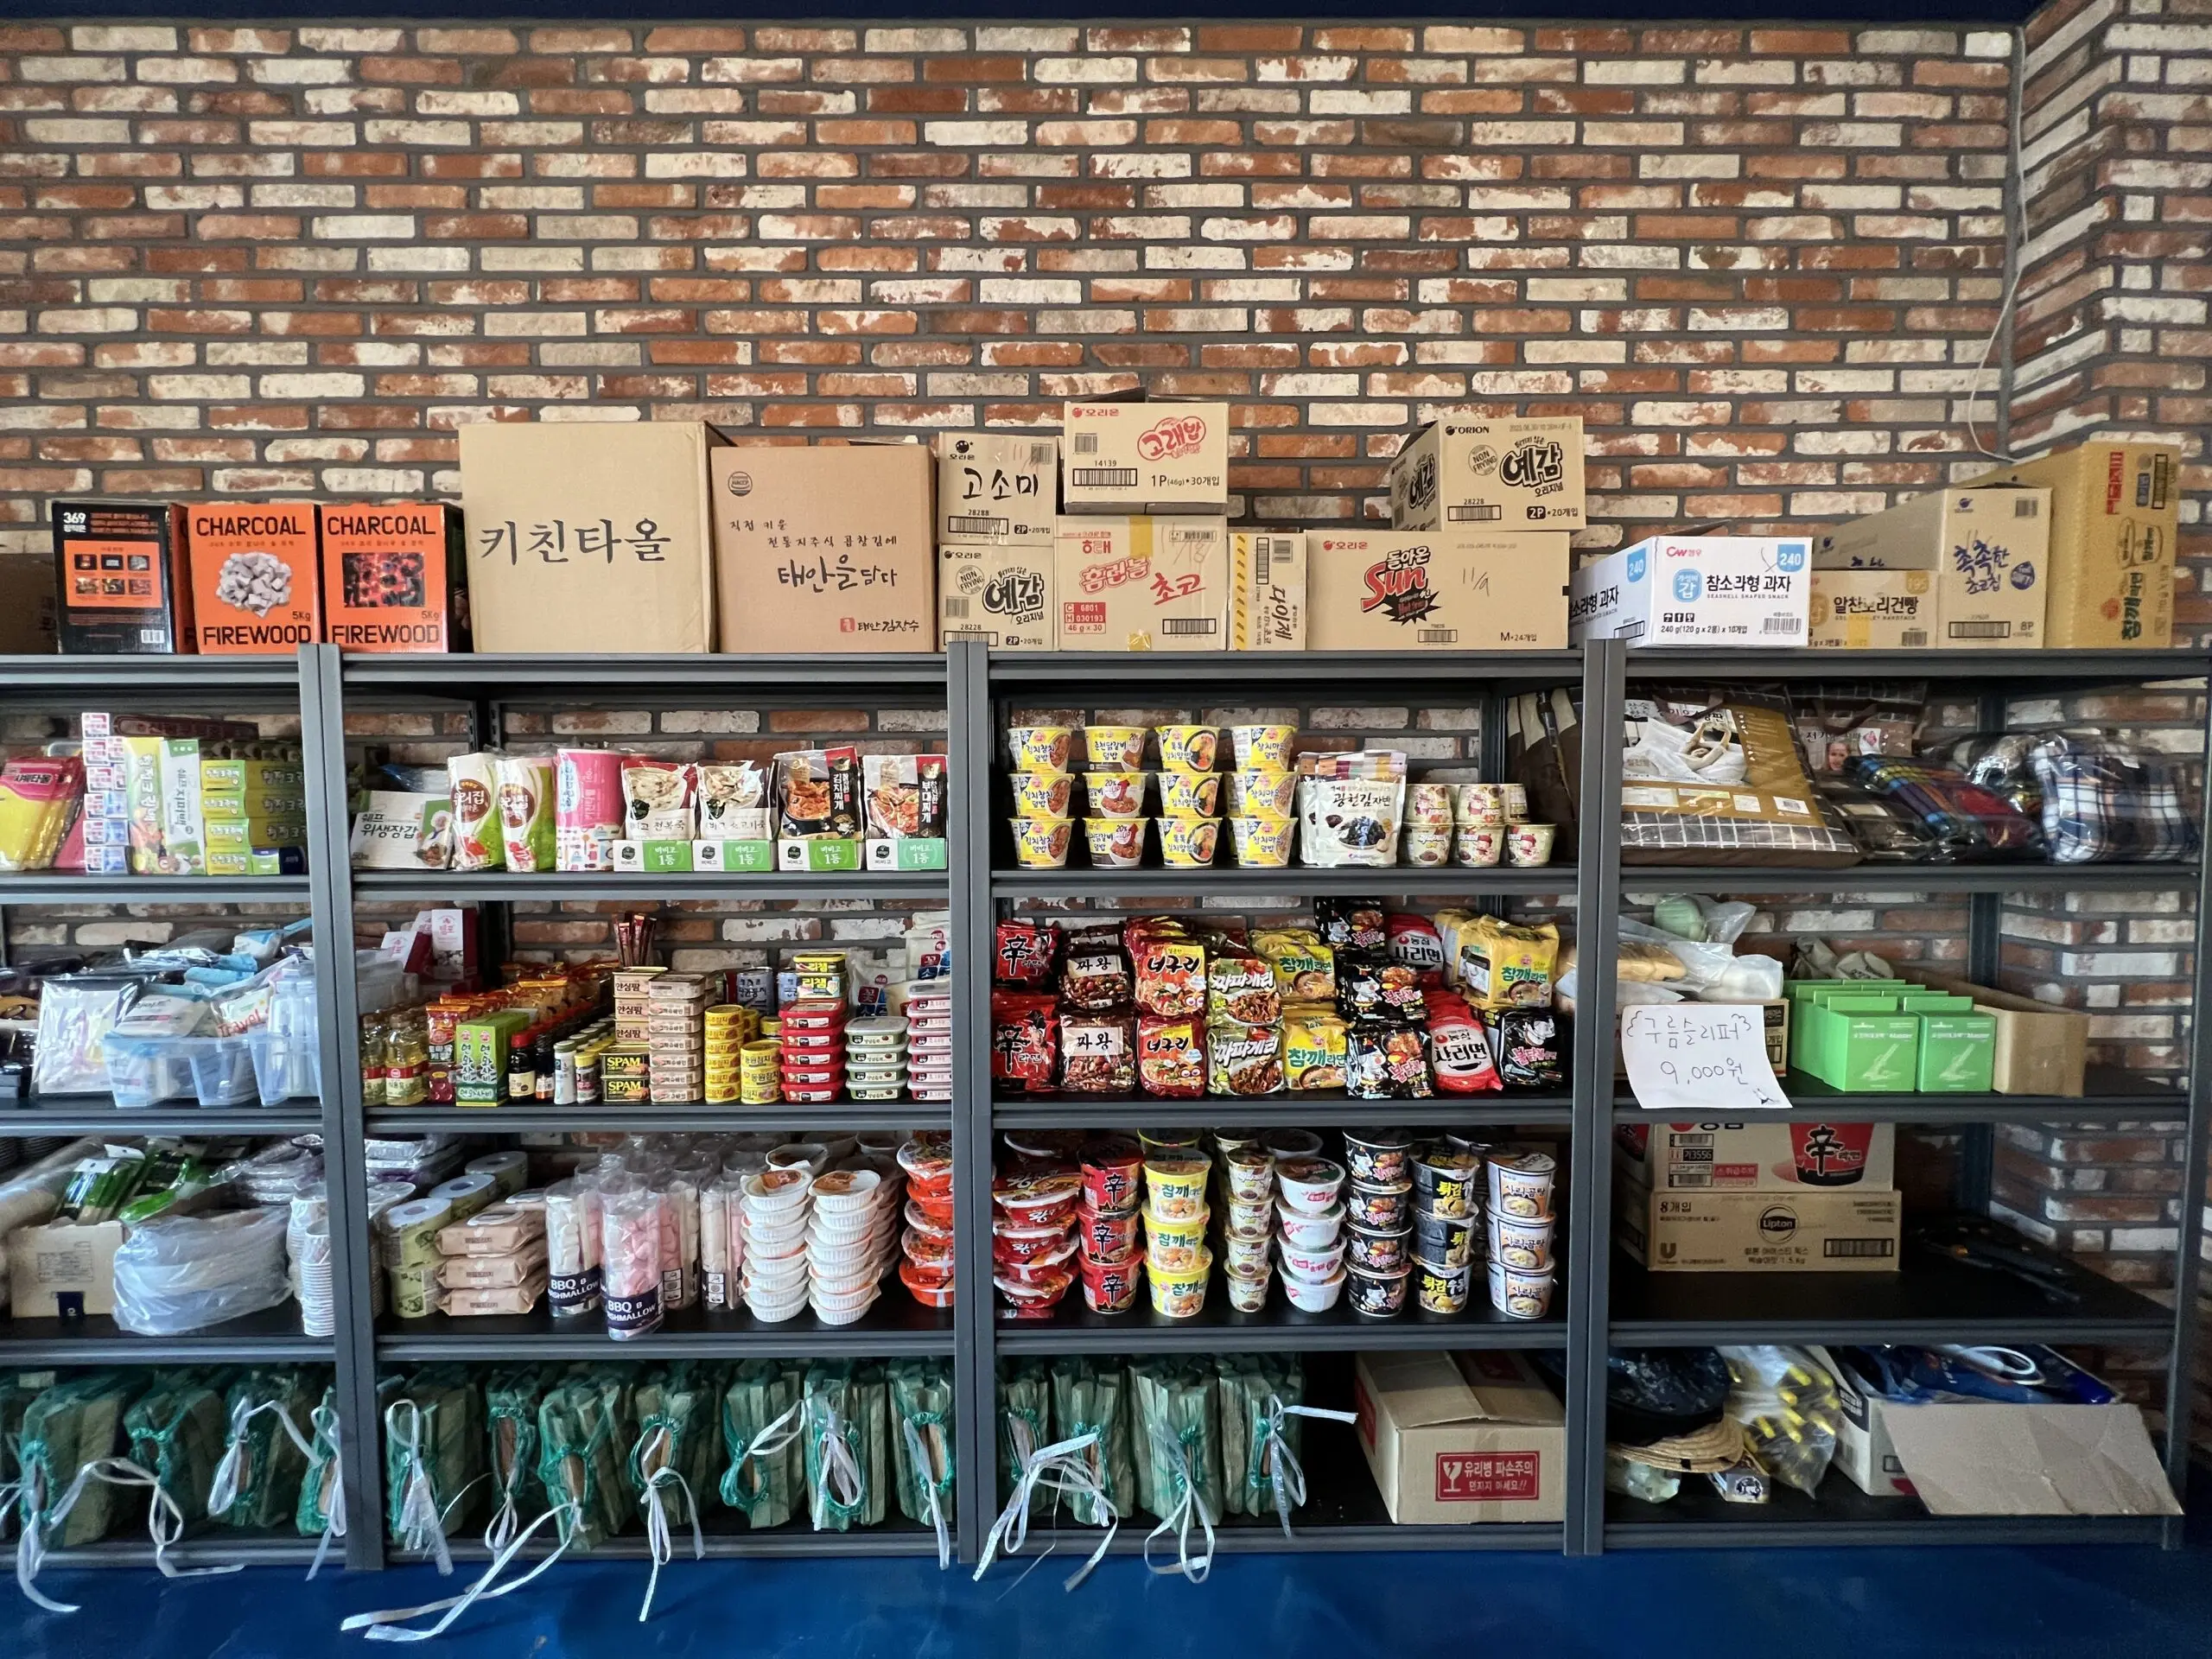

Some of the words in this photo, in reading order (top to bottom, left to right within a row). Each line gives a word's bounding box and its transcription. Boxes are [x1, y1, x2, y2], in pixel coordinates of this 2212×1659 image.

[1141, 421, 1201, 457] 고래밥
[1472, 450, 1490, 462] NON
[1472, 456, 1497, 472] FRYING
[1502, 442, 1562, 486] 예감
[963, 467, 1039, 500] 고소미
[1535, 483, 1564, 497] 오리지널
[63, 512, 86, 524] 369
[1529, 507, 1544, 518] 2P
[196, 516, 306, 536] CHARCOAL
[327, 516, 435, 536] CHARCOAL
[730, 520, 754, 531] 직접
[764, 519, 787, 531] 키운
[1016, 525, 1027, 534] 2P
[480, 518, 671, 565] 키친타올
[768, 536, 834, 548] 전통지주식
[844, 535, 897, 546] 곱창김에
[1336, 541, 1368, 550] 오리온
[1387, 546, 1431, 570] 돌아온
[1780, 552, 1801, 565] 240
[1954, 540, 2010, 577] 촉촉한
[1628, 559, 1643, 575] 240
[960, 570, 977, 582] NON
[1707, 575, 1759, 592] 참소라형
[1764, 575, 1790, 592] 과자
[960, 577, 984, 591] FRYING
[1150, 572, 1206, 605] 초코
[1361, 561, 1427, 613] Sun
[1679, 582, 1696, 598] 갑
[1966, 574, 2001, 594] 초코칩
[985, 574, 1044, 613] 예감
[1599, 586, 1619, 607] 과자
[292, 611, 311, 621] 5Kg
[422, 611, 440, 621] 5Kg
[1016, 612, 1045, 625] 오리지널
[1269, 585, 1293, 640] 다이제
[2020, 621, 2033, 631] 8P
[203, 625, 311, 645] FIREWOOD
[332, 624, 440, 644] FIREWOOD
[1007, 637, 1020, 645] 2P
[833, 773, 844, 810] 김치찌개
[921, 781, 931, 823] 부대찌개
[361, 814, 385, 823] 쉐프
[653, 820, 685, 831] 전복죽
[361, 823, 418, 838] 위생장갑
[658, 855, 676, 866] 1등
[739, 854, 755, 865] 1등
[824, 854, 842, 865] 1등
[913, 854, 930, 864] 1등
[1409, 937, 1430, 945] 농심
[1001, 934, 1034, 975] 辛
[1394, 945, 1441, 963] 사리면
[809, 963, 828, 972] 리챔
[1077, 956, 1112, 972] 짜왕
[1147, 956, 1199, 975] 너구리
[1502, 965, 1548, 982] 참깨라면
[616, 982, 640, 991] 안심팜
[802, 978, 827, 988] 리챔
[1211, 970, 1274, 994] 짜파게티
[618, 1006, 642, 1014] 안심팜
[216, 1008, 261, 1037] Travel
[616, 1029, 640, 1039] 안심팜
[1077, 1032, 1112, 1051] 짜왕
[995, 1026, 1031, 1073] 辛
[1146, 1037, 1188, 1052] 너구리
[1214, 1037, 1278, 1066] 짜파게티
[1434, 1043, 1488, 1063] 사리면
[607, 1057, 641, 1067] SPAM
[1660, 1057, 1748, 1086] 9,000원
[607, 1081, 641, 1090] SPAM
[1807, 1126, 1844, 1177] 辛
[1103, 1173, 1126, 1203] 辛
[1505, 1185, 1545, 1196] 사리곰탕
[1660, 1202, 1692, 1213] 8개입
[1764, 1218, 1794, 1229] Lipton
[1093, 1224, 1116, 1253] 辛
[1505, 1236, 1544, 1249] 사리곰탕
[551, 1279, 576, 1290] BBQ
[1103, 1274, 1123, 1303] 辛
[608, 1300, 632, 1313] BBQ
[1465, 1460, 1492, 1478] 유리병
[1496, 1460, 1534, 1477] 파손주의
[1469, 1480, 1492, 1492] 던지지
[1496, 1479, 1528, 1492] 마세요!!
